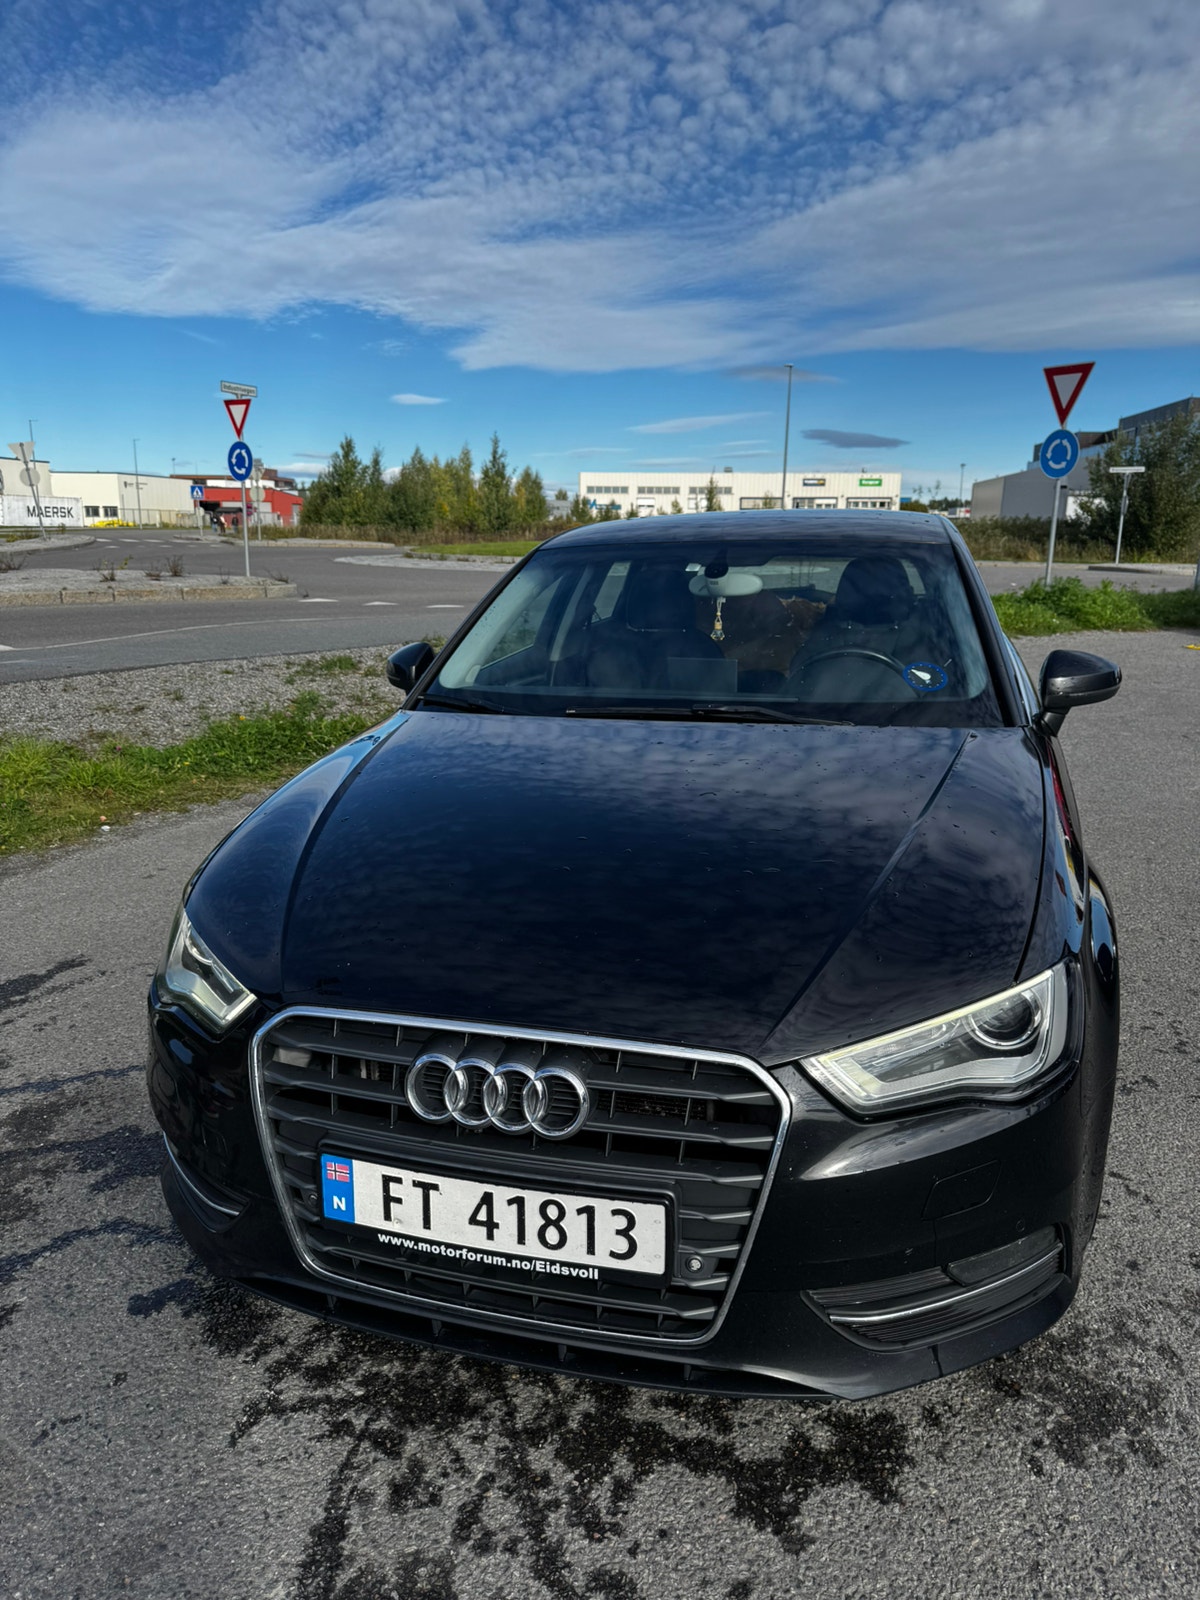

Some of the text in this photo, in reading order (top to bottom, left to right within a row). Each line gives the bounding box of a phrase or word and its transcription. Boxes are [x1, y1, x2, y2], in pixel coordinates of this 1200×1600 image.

[26, 505, 74, 518] MAERSK
[332, 1195, 346, 1211] N
[381, 1174, 639, 1261] FT 41813
[377, 1233, 599, 1280] www.motorforum.no/Eidsvoll
